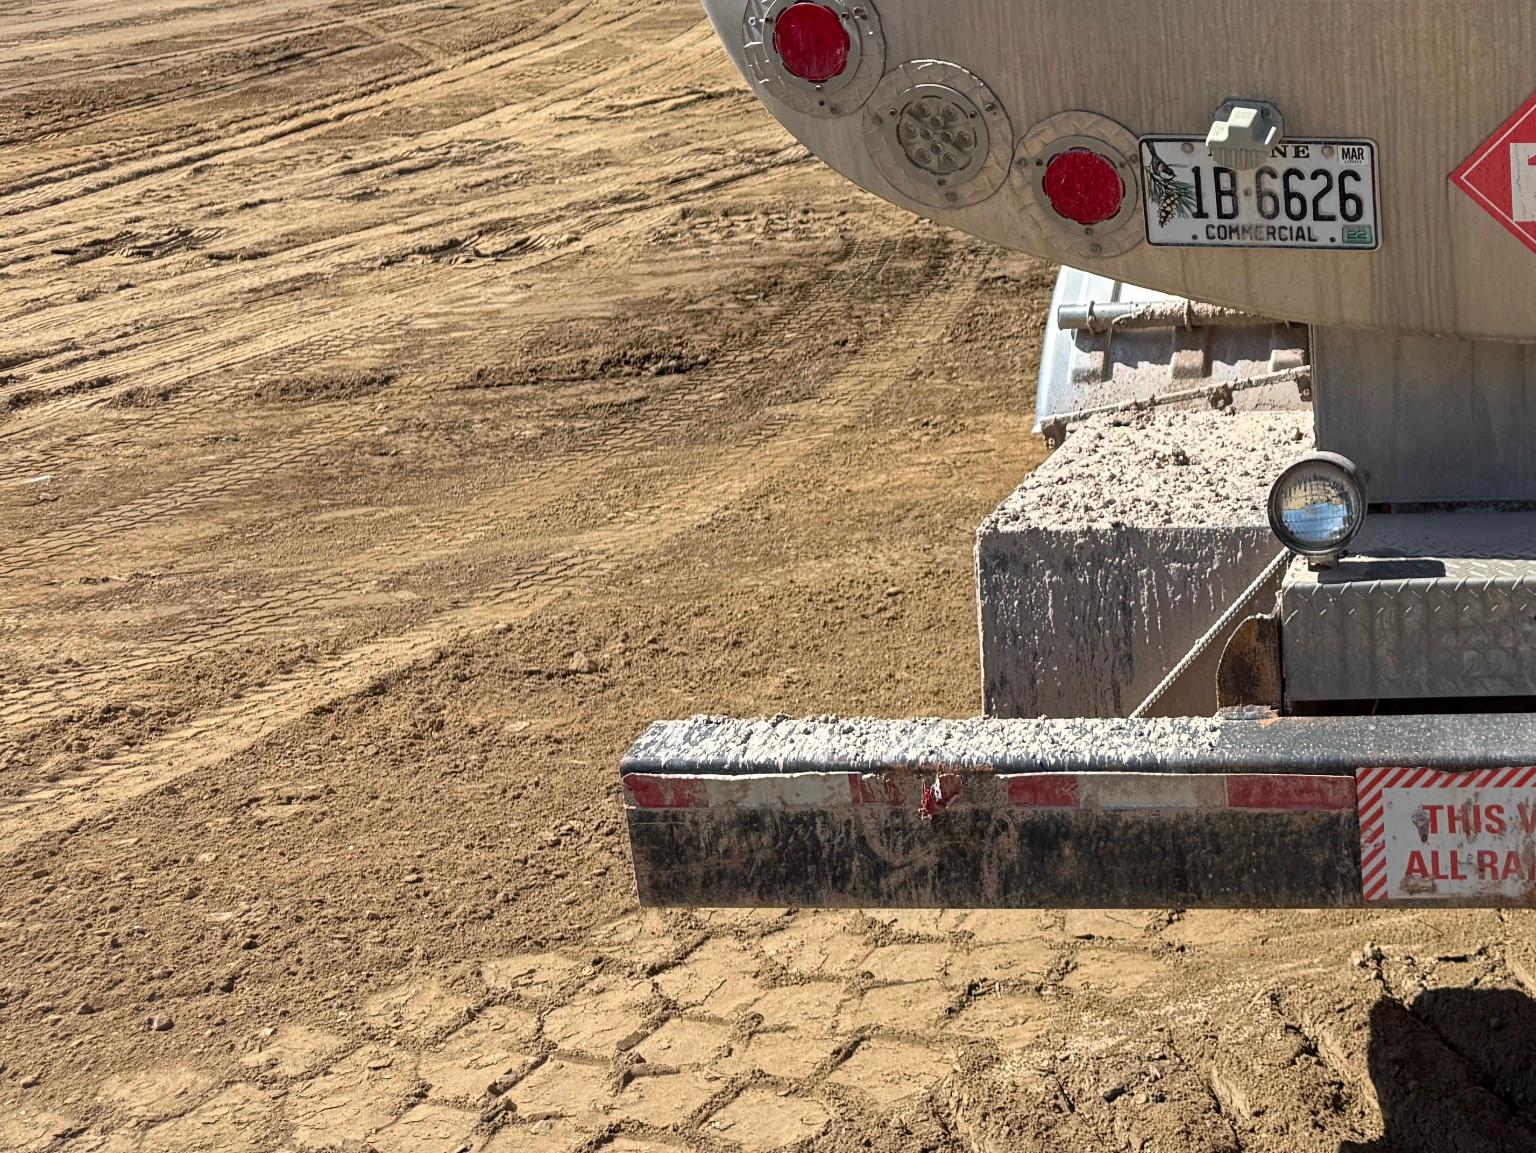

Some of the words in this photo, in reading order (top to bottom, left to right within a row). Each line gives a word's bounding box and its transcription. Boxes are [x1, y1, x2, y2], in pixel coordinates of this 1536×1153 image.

[1341, 147, 1365, 161] MAR
[1254, 165, 1364, 223] 6626
[1205, 224, 1319, 243] COMMERCIAL
[1422, 804, 1505, 835] THIS
[1405, 850, 1468, 880] ALL
